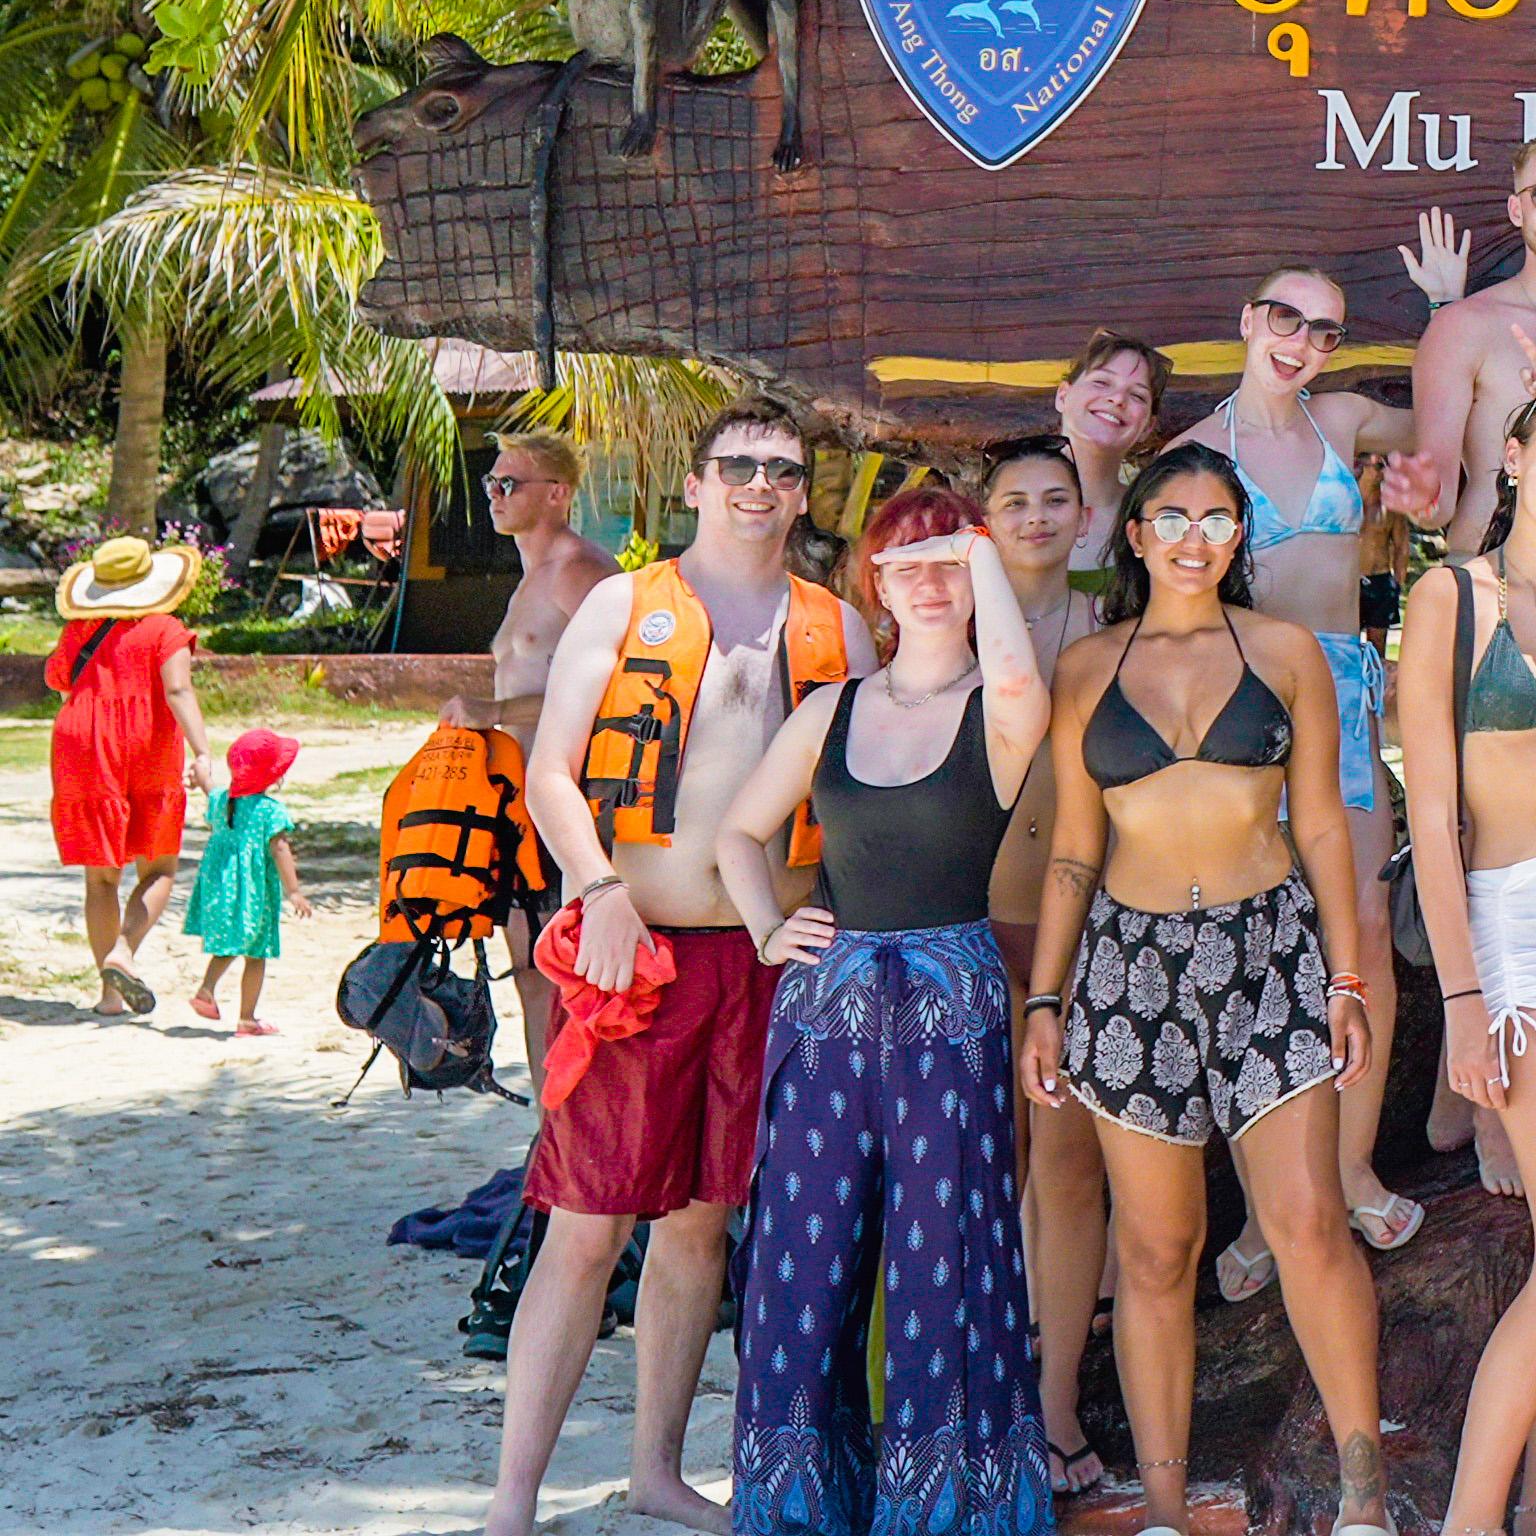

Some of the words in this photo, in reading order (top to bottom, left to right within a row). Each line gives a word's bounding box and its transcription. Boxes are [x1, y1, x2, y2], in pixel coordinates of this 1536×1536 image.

[889, 2, 924, 54] Ang
[920, 49, 980, 125] Thong
[1011, 5, 1115, 125] National
[1315, 89, 1479, 172] Mu
